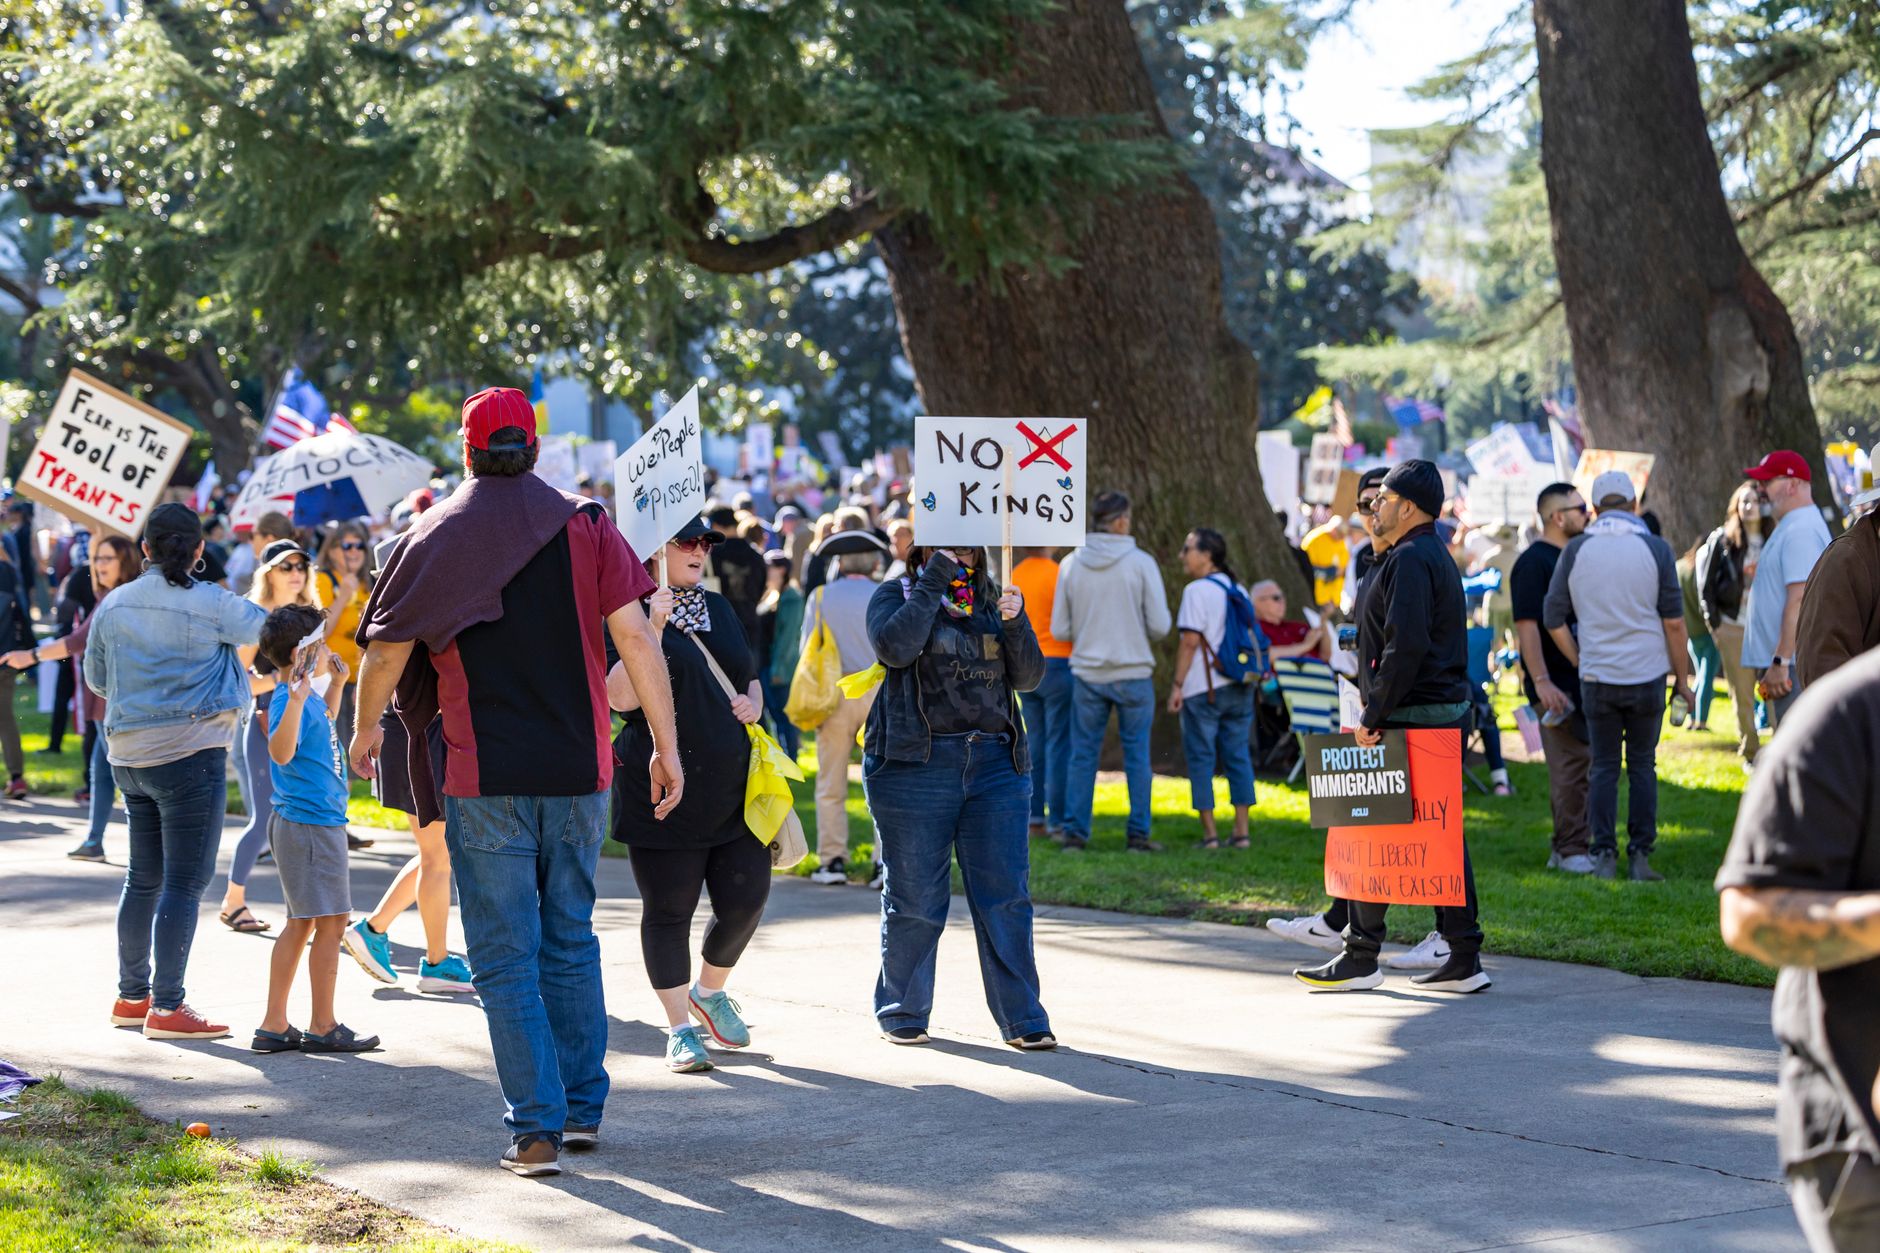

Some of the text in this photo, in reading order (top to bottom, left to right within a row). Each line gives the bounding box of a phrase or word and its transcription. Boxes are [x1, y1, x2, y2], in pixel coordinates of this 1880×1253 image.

[70, 388, 168, 460] FEAR IS THE
[61, 421, 156, 489] TOOL OF
[628, 452, 657, 483] We
[660, 416, 696, 459] People
[936, 430, 1004, 471] NO
[36, 450, 141, 524] TYRANTS
[650, 461, 701, 520] PISSED!
[1321, 745, 1386, 771] PROTECT
[1310, 770, 1406, 798] IMMIGRANTS
[1351, 807, 1369, 818] ACLU
[1368, 841, 1428, 868] LIBERTY
[1361, 872, 1391, 897] LONG
